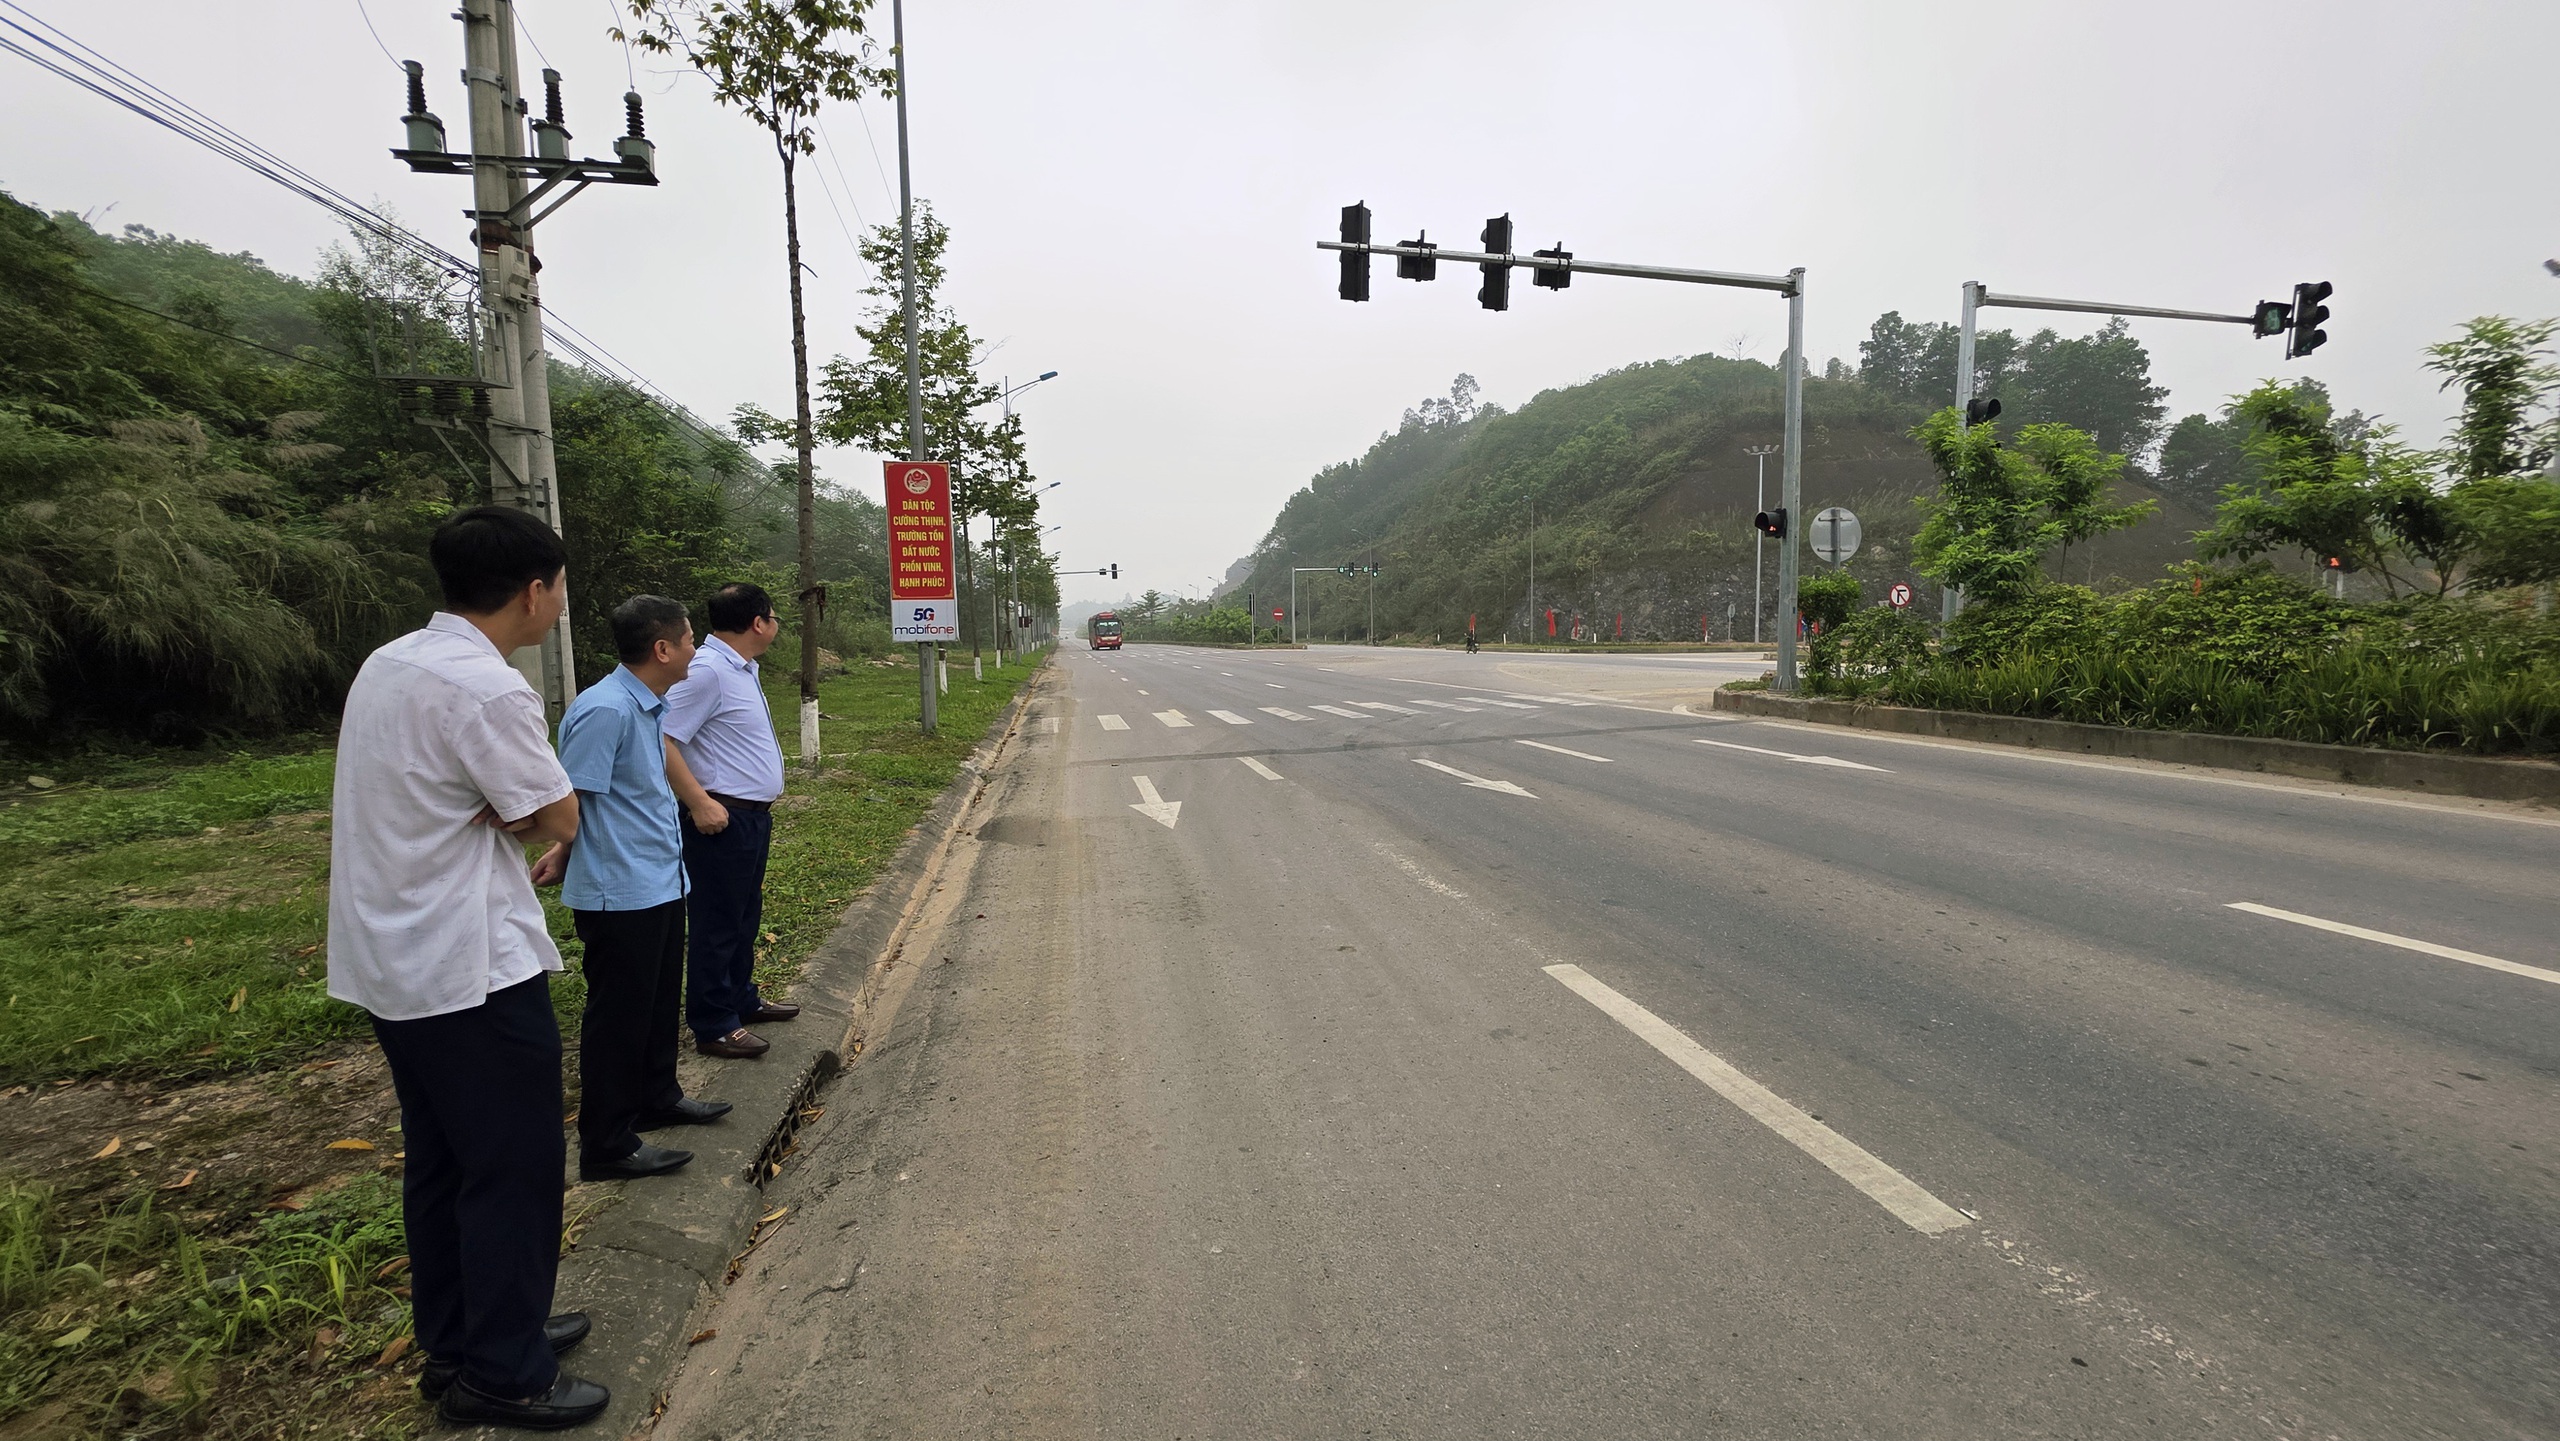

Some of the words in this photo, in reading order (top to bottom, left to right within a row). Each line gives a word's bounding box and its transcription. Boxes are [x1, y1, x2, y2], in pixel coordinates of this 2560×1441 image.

[902, 499, 919, 510] DÂN
[920, 499, 935, 512] TỘC
[893, 514, 920, 526] CƯỜNG
[896, 529, 927, 541] TRƯỜNG
[902, 544, 917, 556] ĐẤT
[918, 545, 940, 556] NƯỚC
[922, 562, 944, 573] VINH,
[899, 577, 921, 589] HẠNH
[922, 575, 945, 587] PHÚC!
[913, 607, 935, 621] 5G
[894, 624, 954, 634] mobifone
